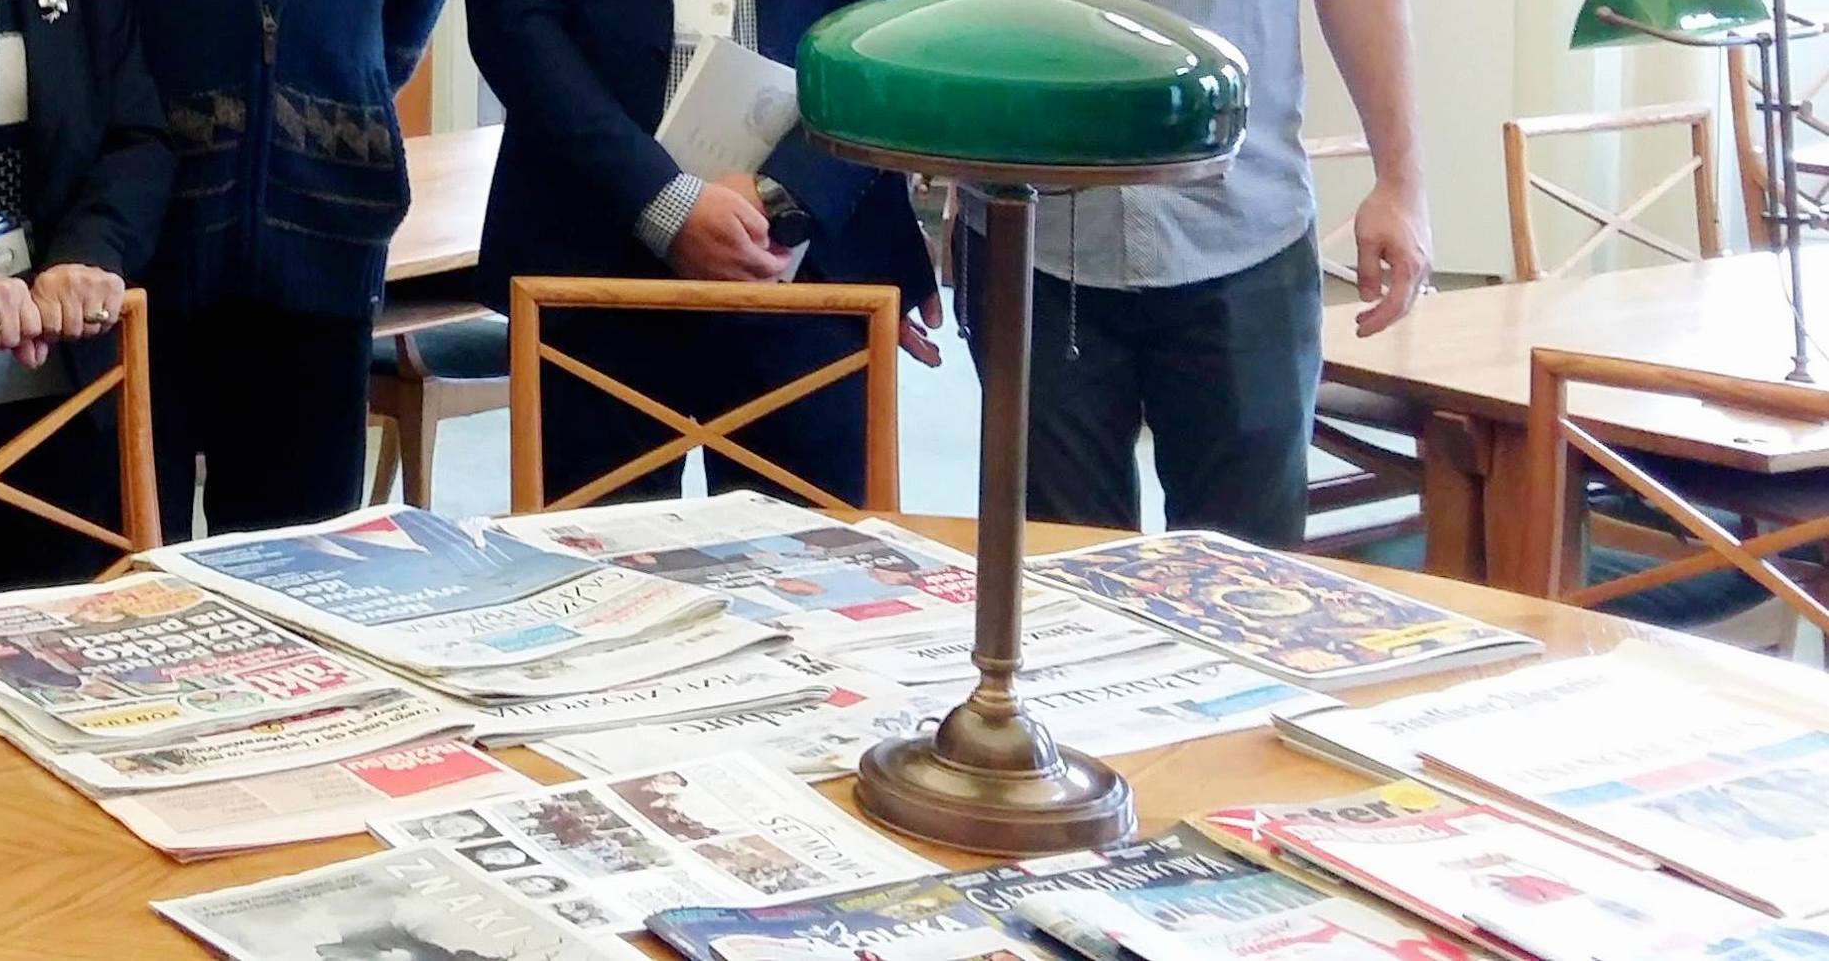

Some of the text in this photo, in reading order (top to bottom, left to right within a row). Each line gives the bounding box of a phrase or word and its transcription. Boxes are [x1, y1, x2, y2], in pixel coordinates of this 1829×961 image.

[186, 610, 235, 626] na
[83, 621, 259, 660] dziecko
[1075, 852, 1235, 892] BANKOWA
[384, 858, 532, 939] ZNAKI
